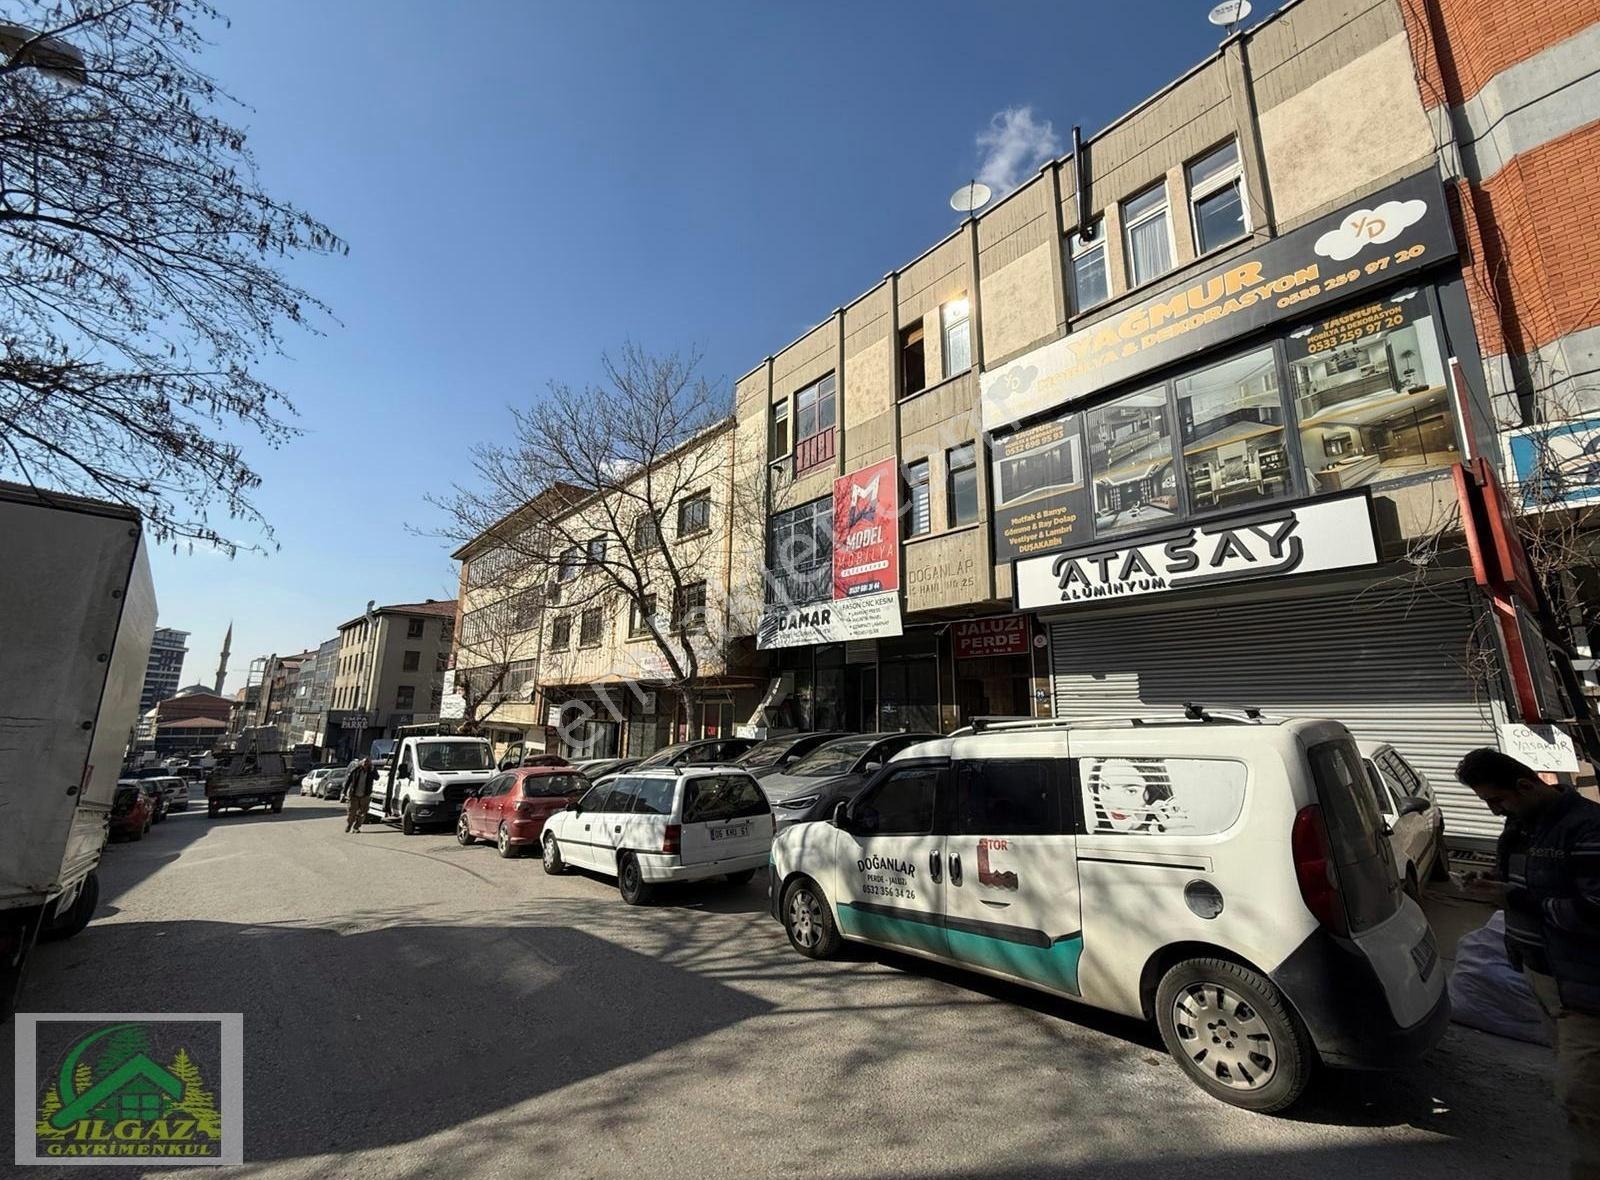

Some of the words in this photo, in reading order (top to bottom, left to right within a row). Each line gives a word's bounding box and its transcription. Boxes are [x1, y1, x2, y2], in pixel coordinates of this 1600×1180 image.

[1364, 256, 1391, 275] 97
[1394, 244, 1426, 264] 20
[1067, 261, 1266, 361] YAĞMUR
[1140, 263, 1320, 348] DEKORASYON
[1307, 337, 1338, 354] 0533
[1340, 328, 1363, 344] 259
[1366, 321, 1382, 335] 97
[1385, 314, 1404, 329] 20
[1053, 514, 1077, 526] Dolap
[845, 525, 884, 551] MODEL
[1052, 509, 1304, 590] ATASAY
[1060, 577, 1167, 601] ALÜMİNYUM
[778, 609, 832, 632] DAMAR
[957, 616, 1025, 637] JALUZİ
[961, 633, 1021, 649] PERDE
[857, 854, 916, 878] DOĞANLAR
[905, 889, 916, 899] 26
